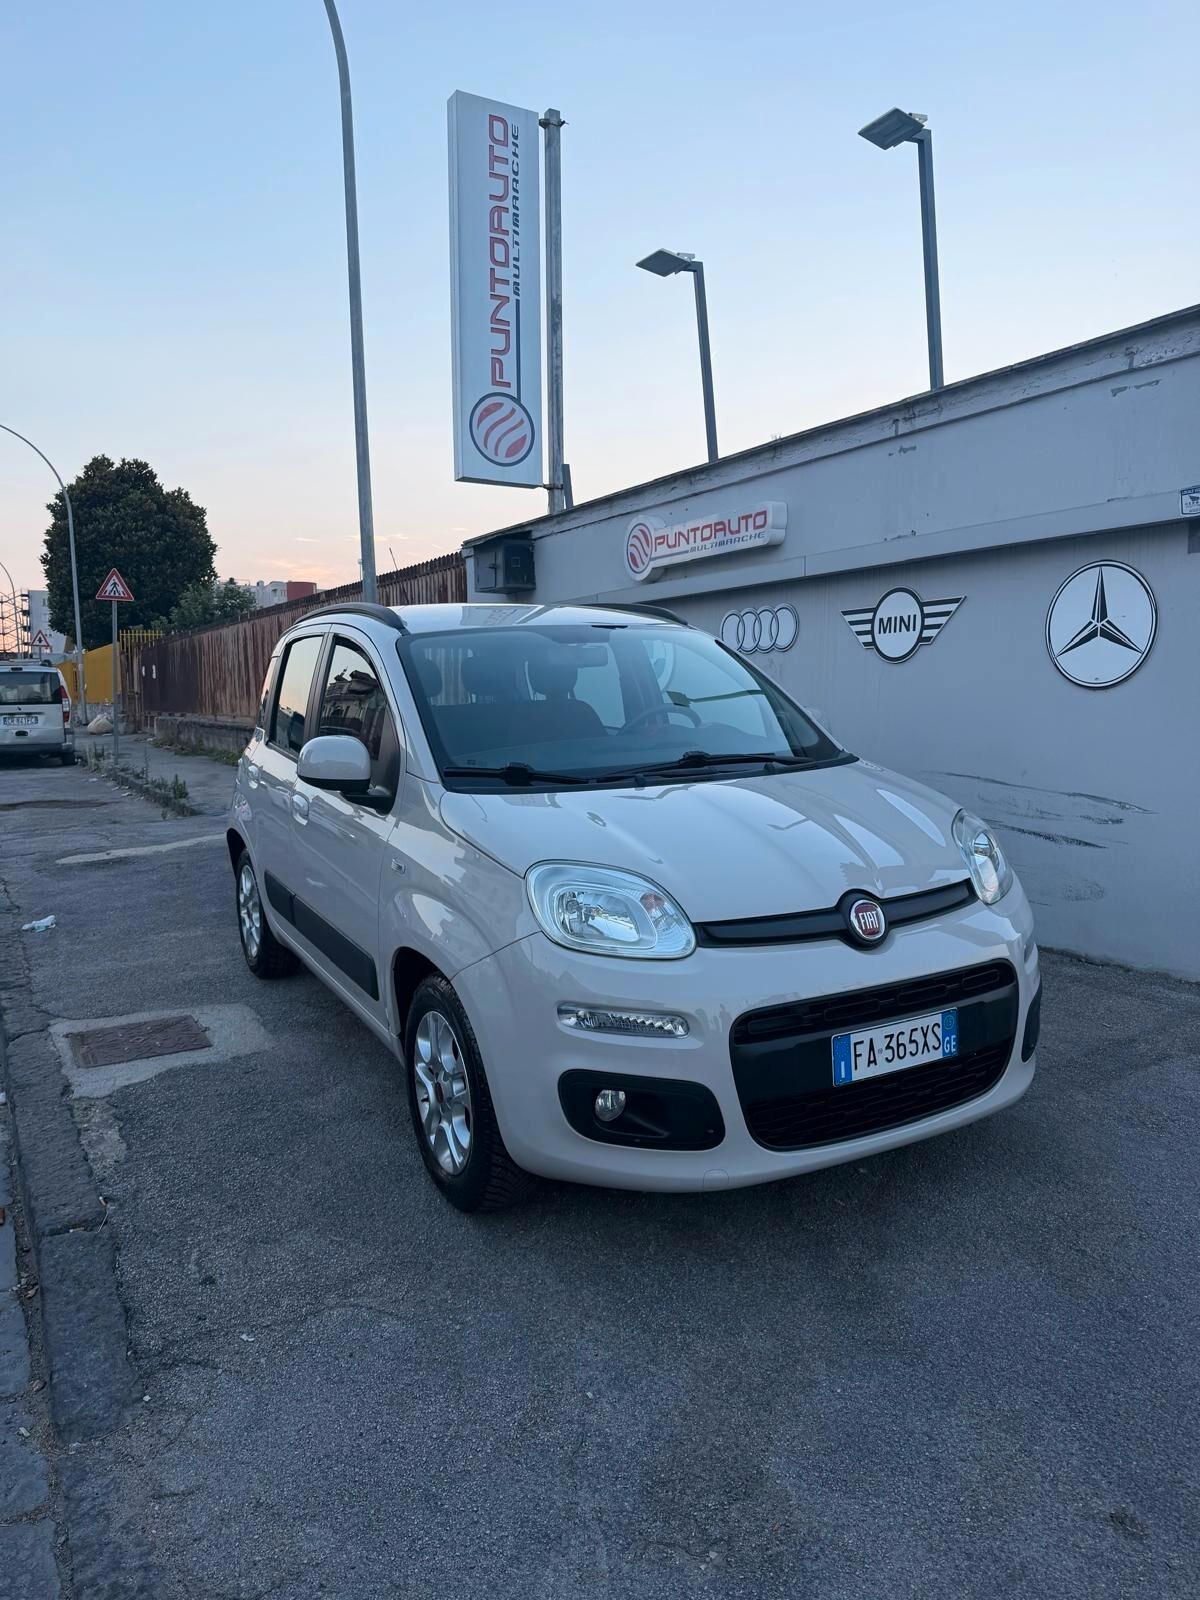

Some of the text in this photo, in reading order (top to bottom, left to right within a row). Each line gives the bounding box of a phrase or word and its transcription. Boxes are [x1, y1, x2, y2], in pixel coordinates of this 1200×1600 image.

[511, 124, 520, 297] MULTIMARCHE
[488, 113, 511, 388] PUNTOAUTO
[654, 510, 767, 552] PUNTOAUTO
[690, 532, 766, 552] MULTIMARCHE
[878, 614, 917, 635] MINI
[858, 911, 879, 930] FIAT
[840, 1061, 846, 1078] I
[853, 1037, 878, 1071] FA
[884, 1022, 942, 1063] 365XS
[944, 1035, 957, 1053] GE
